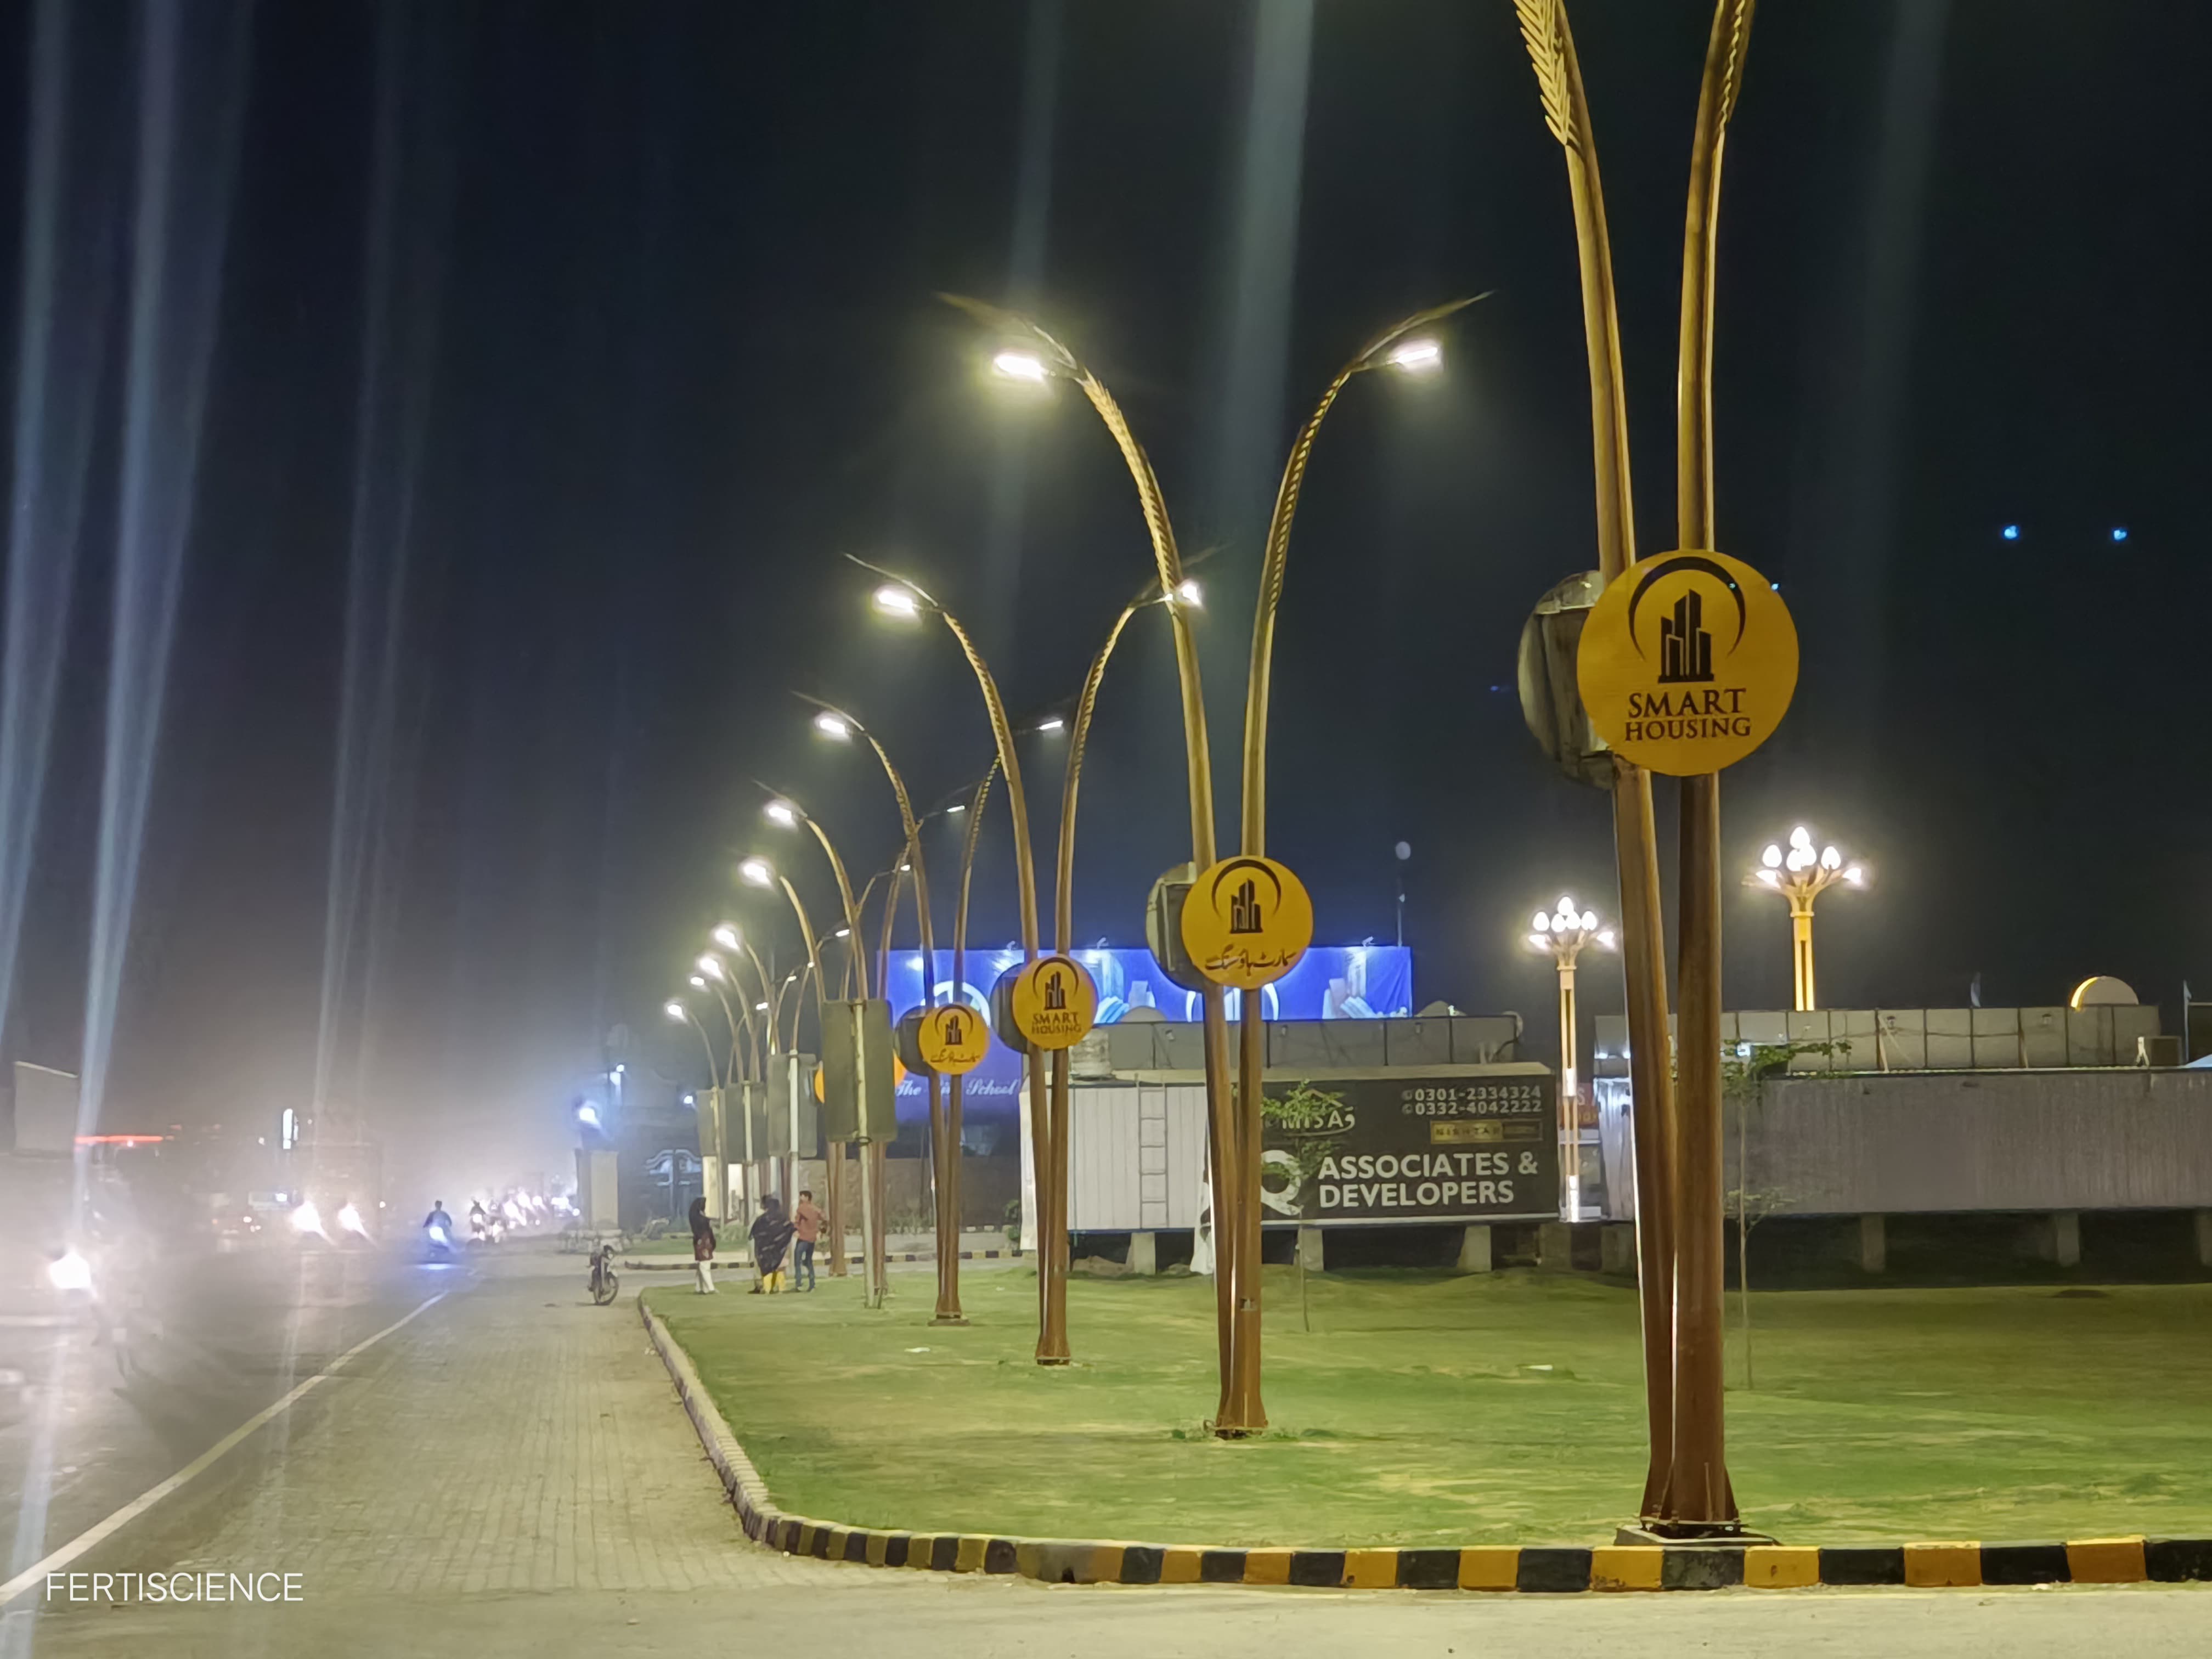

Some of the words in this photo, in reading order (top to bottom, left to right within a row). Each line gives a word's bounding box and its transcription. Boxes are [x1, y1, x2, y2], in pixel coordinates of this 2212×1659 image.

[1628, 687, 1747, 719] SMART
[1625, 717, 1751, 741] HOUSING
[1032, 1012, 1078, 1025] SMART
[1031, 1023, 1082, 1035] HOUSING
[896, 1080, 922, 1097] The
[966, 1079, 1019, 1096] School
[1414, 1085, 1541, 1102] 0301-2334324
[1415, 1099, 1543, 1115] 0332-4042222
[1318, 1152, 1509, 1180] ASSOCIATES
[1518, 1152, 1538, 1175] &
[1319, 1180, 1514, 1207] DEVELOPERS
